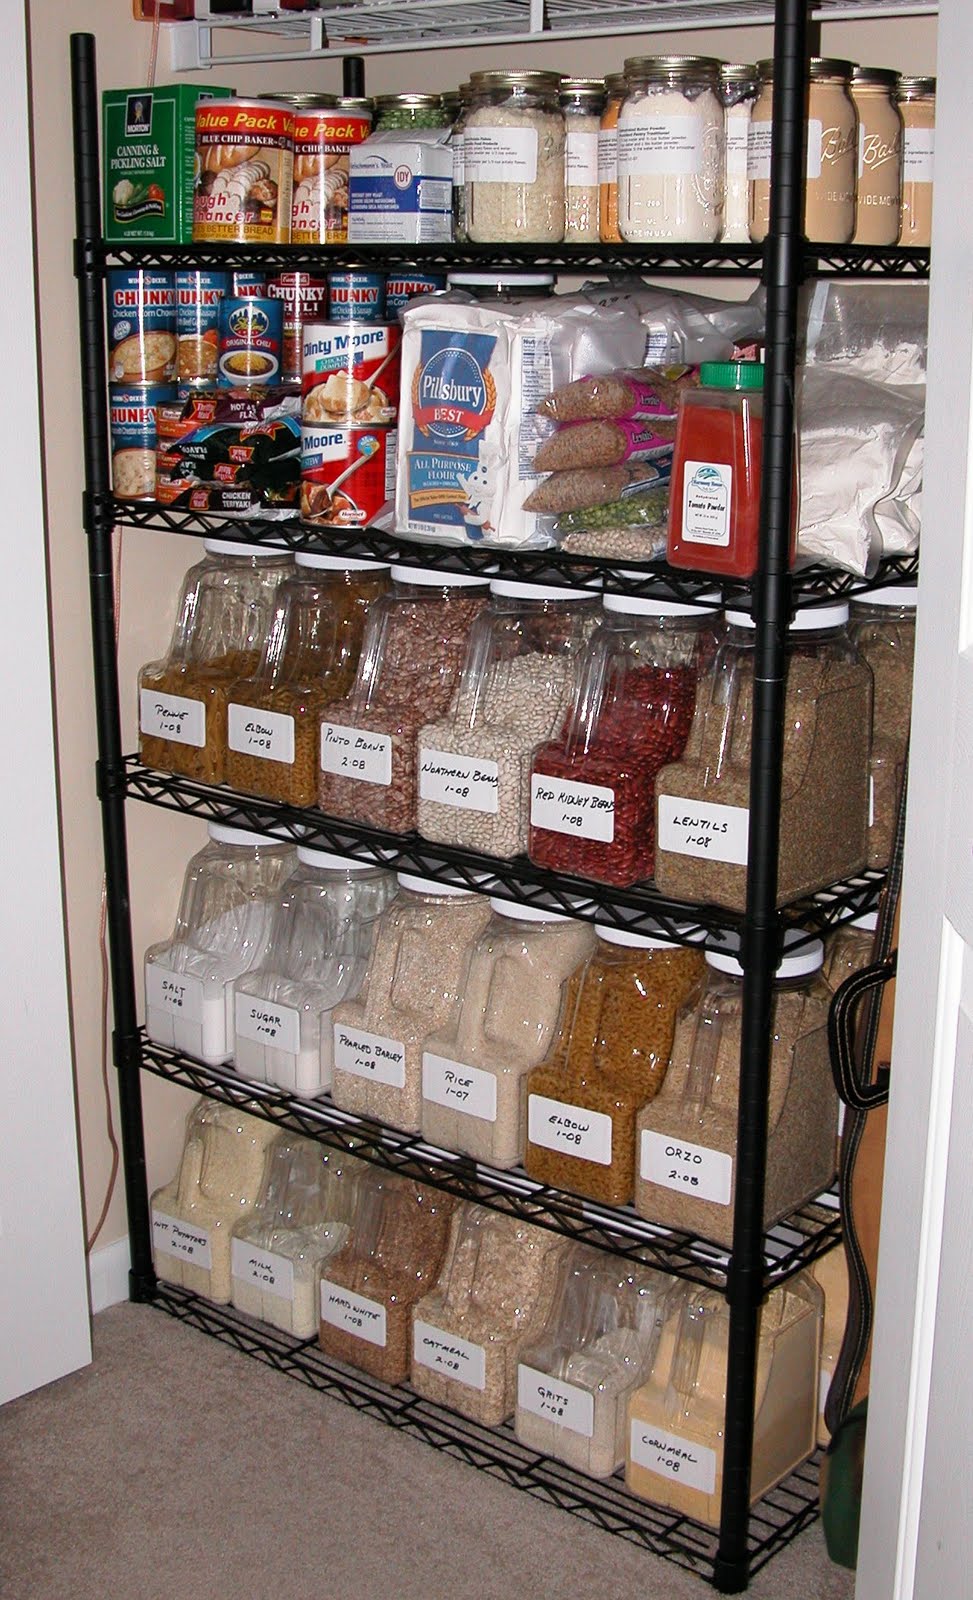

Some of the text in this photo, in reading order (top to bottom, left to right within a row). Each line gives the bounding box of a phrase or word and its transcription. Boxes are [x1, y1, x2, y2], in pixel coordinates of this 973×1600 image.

[233, 113, 277, 130] Pack
[313, 123, 355, 138] Pack
[202, 135, 274, 145] BLUE CHIP BAKER
[116, 144, 159, 157] CANNING &
[110, 156, 167, 170] PICKLING SALT
[397, 171, 409, 182] IDY
[206, 225, 240, 233] BETTER
[243, 225, 274, 235] BREAD
[267, 283, 325, 301] CHUNKY
[330, 287, 380, 304] HUNKY
[387, 281, 436, 297] HUNKY
[283, 302, 319, 312] HILI
[255, 339, 272, 348] CHILI
[422, 374, 483, 408] Pillsbury
[230, 403, 246, 412] HOT
[434, 408, 464, 422] BEST
[304, 433, 343, 450] Moore
[415, 457, 472, 472] ALL PURPOSE
[428, 471, 455, 481] FLOUR
[221, 492, 252, 500] CHICKEN
[222, 500, 252, 509] TERIYAKI
[688, 500, 726, 512] Tomato Powder
[154, 703, 189, 721] PENNE
[159, 722, 182, 734] 1-08
[244, 722, 274, 736] ELBOW
[248, 736, 272, 750] 1-08
[325, 727, 386, 752] PINTO BEANS
[421, 762, 471, 780] NORTHERN
[444, 785, 470, 798] 1-08
[535, 786, 616, 813] RED KIDNEY BEANS
[562, 813, 583, 827] 1-08
[672, 815, 729, 834] LENTILS
[686, 835, 712, 848] 1-08
[161, 980, 185, 998] SALT
[164, 995, 183, 1007] 1-08
[249, 1009, 282, 1028] SUGAR
[256, 1025, 277, 1037] 1-08
[339, 1034, 403, 1064] PEARLED BARLEY
[354, 1058, 376, 1070] 1-08
[444, 1070, 474, 1088] RICE
[445, 1087, 470, 1101] 1-07
[548, 1115, 590, 1132] ELBOW
[556, 1130, 582, 1145] 1-08
[664, 1145, 703, 1165] ORZO
[248, 1258, 273, 1273] MILK
[328, 1295, 381, 1320] HARD WHITE
[344, 1314, 363, 1327] 1-08
[422, 1337, 470, 1361] OATMEAL
[537, 1386, 569, 1406] GRITS
[540, 1401, 564, 1417] 1-08
[656, 1455, 681, 1472] 1-08
